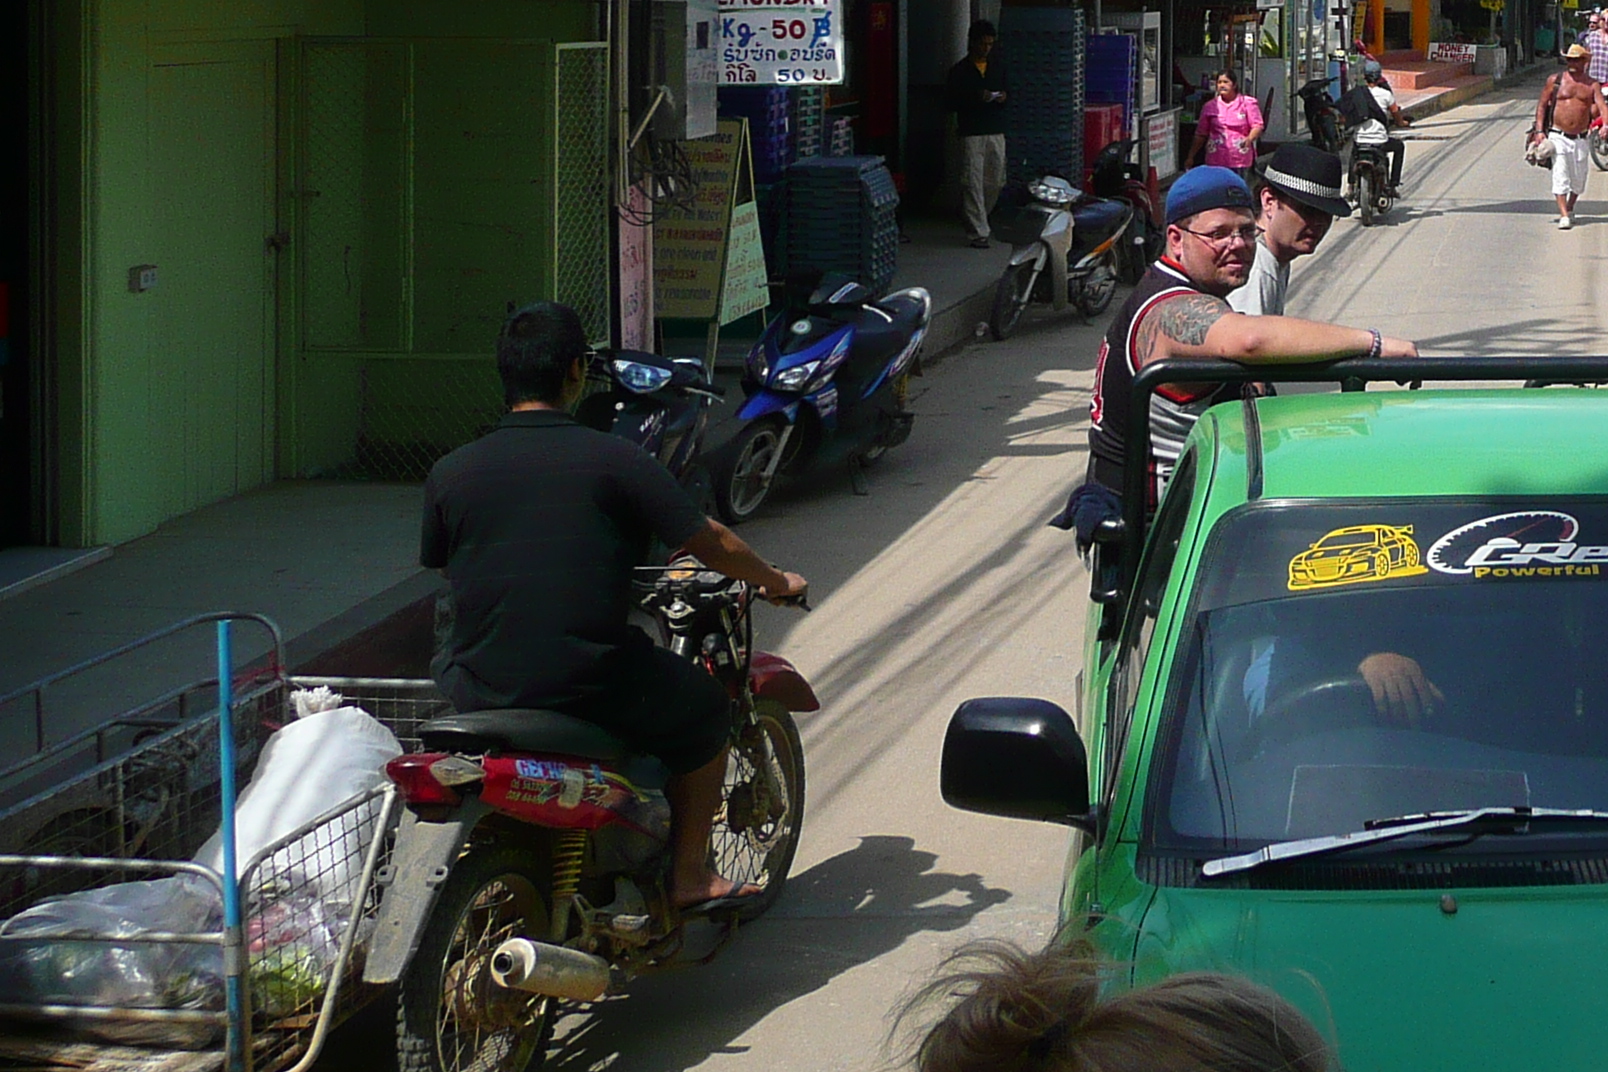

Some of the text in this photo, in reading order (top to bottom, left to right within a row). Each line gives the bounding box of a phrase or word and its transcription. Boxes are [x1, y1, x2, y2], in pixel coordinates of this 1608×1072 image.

[772, 19, 807, 40] 50
[1438, 43, 1469, 53] MONEY
[1431, 51, 1475, 64] CHANGER
[777, 69, 806, 83] 50
[1473, 564, 1600, 579] Powerful
